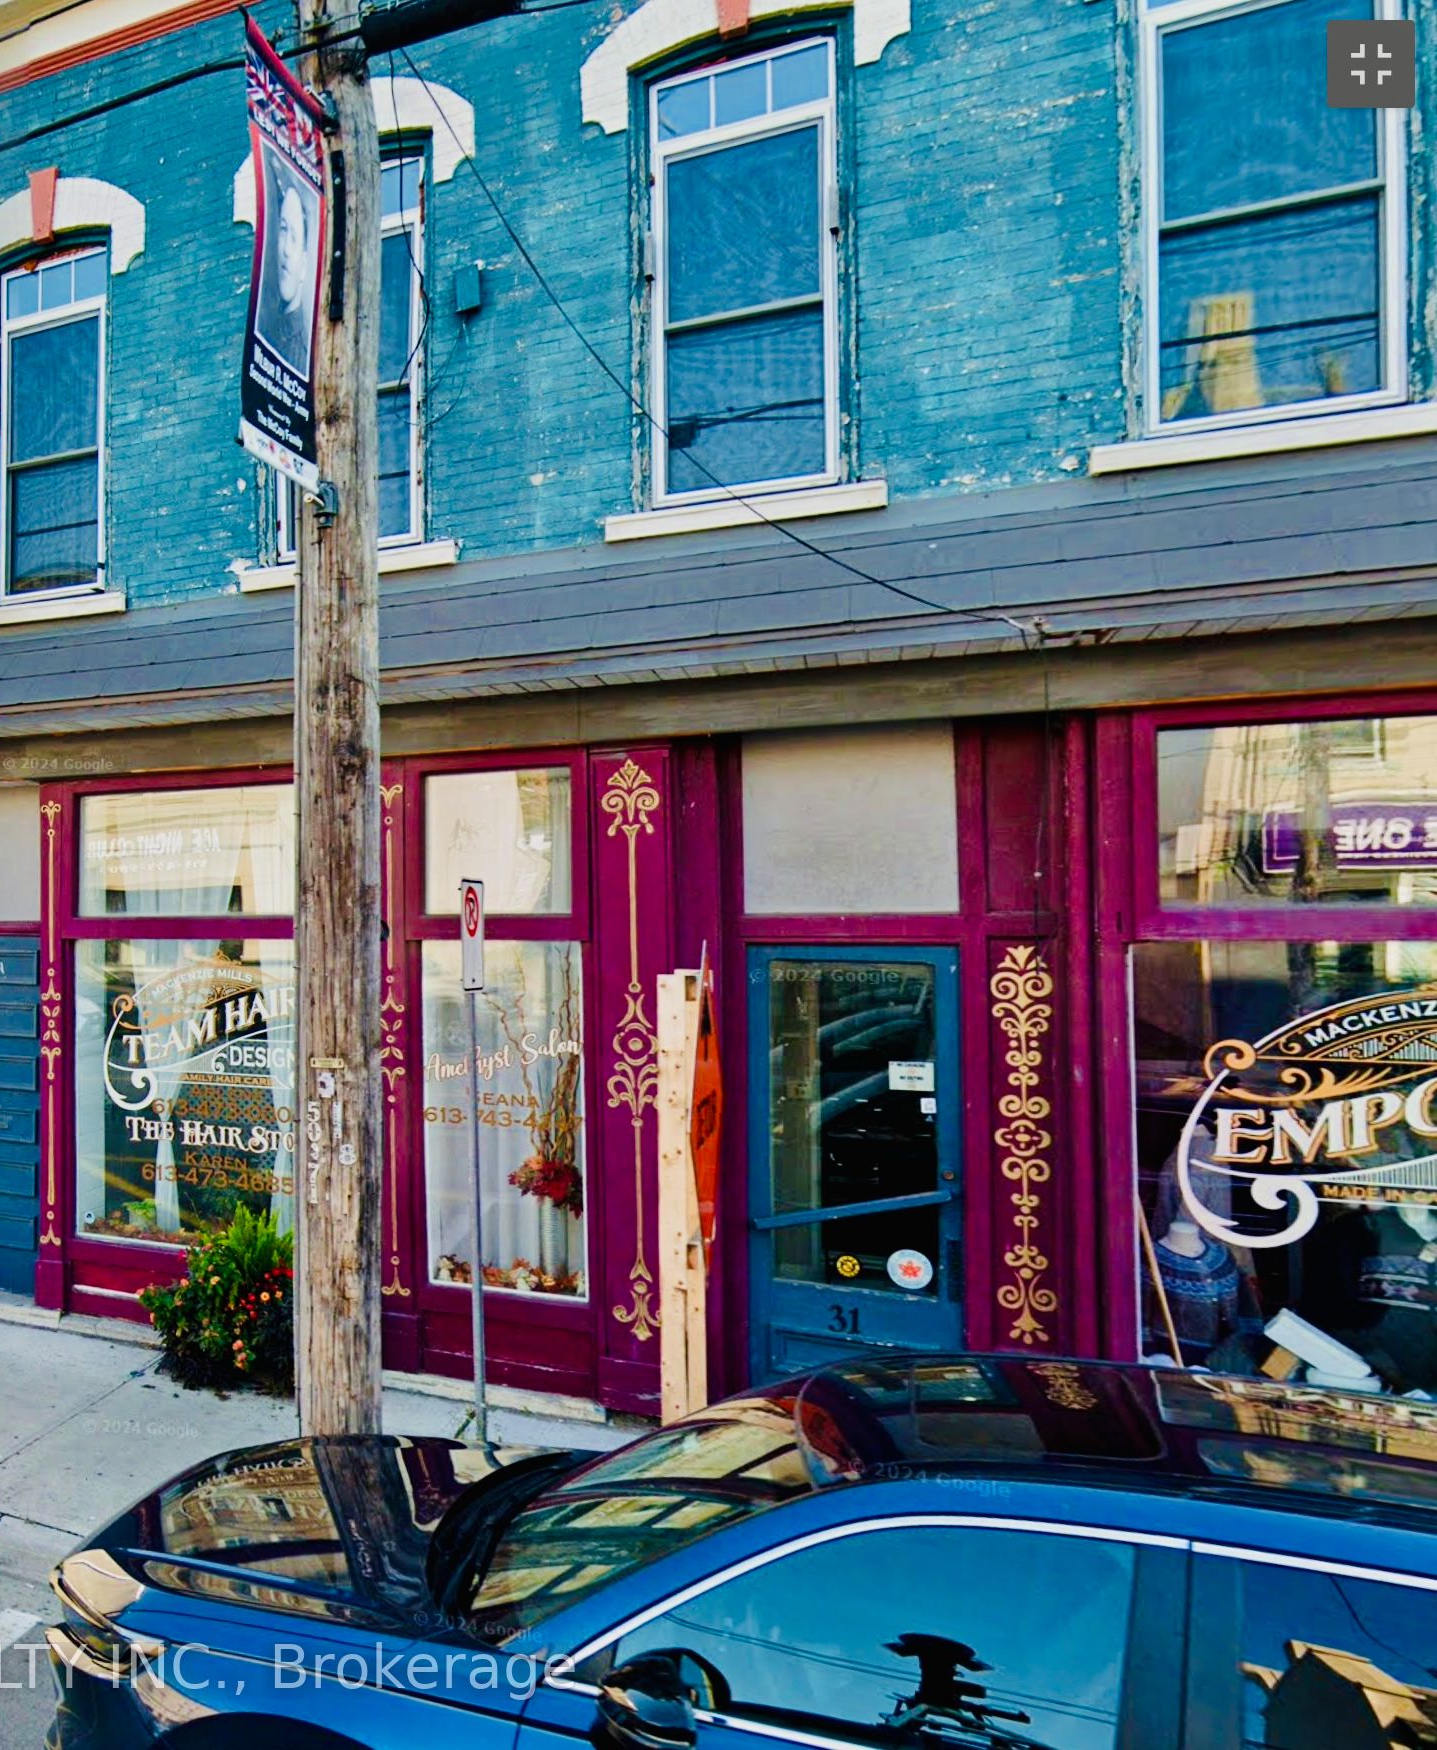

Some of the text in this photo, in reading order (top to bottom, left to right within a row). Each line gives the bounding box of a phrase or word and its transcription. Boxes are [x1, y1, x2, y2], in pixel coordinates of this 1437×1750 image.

[151, 967, 253, 998] MACKENZIE MILLS
[122, 986, 295, 1064] TEAM HAIR
[1303, 1000, 1437, 1048] MACKENZ
[520, 1028, 582, 1065] Salon
[125, 1115, 175, 1142] THE
[180, 1119, 250, 1151] HAIR
[185, 1150, 247, 1170] KAREN
[141, 1162, 295, 1196] 613-473-4685
[1323, 1183, 1379, 1200] MADE
[1384, 1188, 1406, 1204] IN
[827, 1303, 861, 1335] 31
